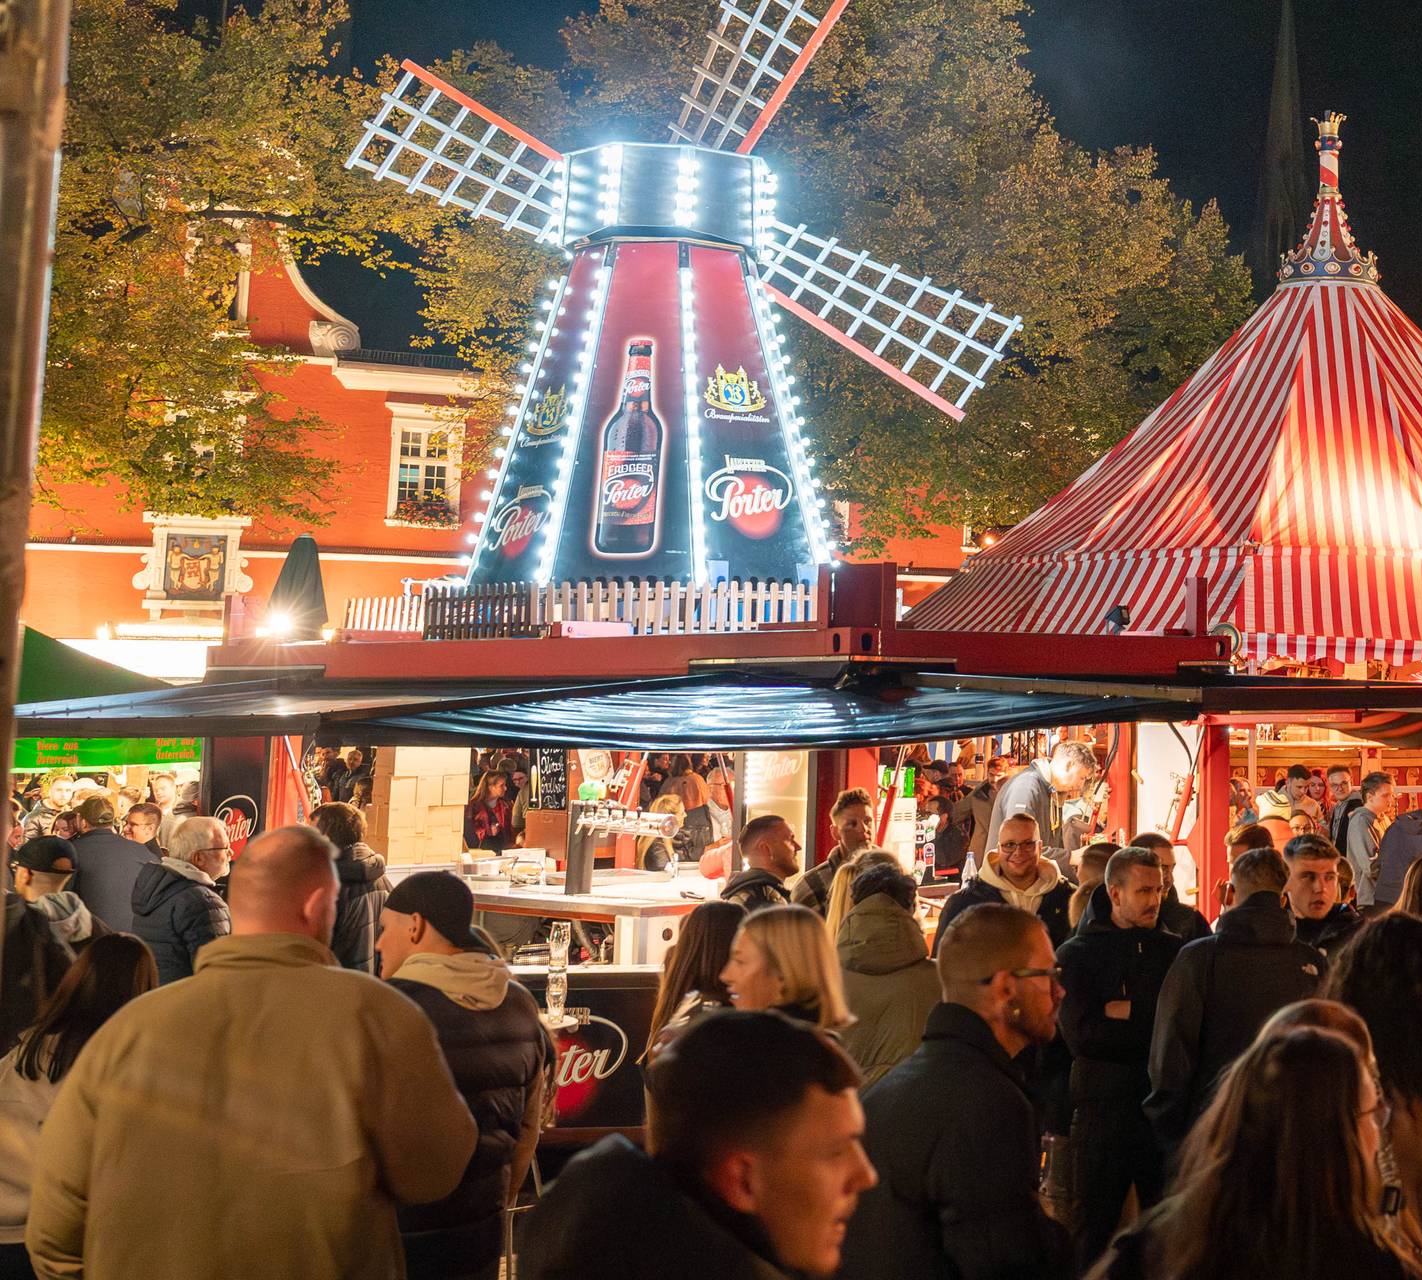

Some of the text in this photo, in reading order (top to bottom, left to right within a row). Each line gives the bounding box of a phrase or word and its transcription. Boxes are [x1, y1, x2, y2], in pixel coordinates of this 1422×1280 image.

[608, 463, 653, 477] ERDBEER
[602, 478, 652, 505] Porter
[708, 471, 785, 521] Porter
[488, 505, 547, 551] Porter
